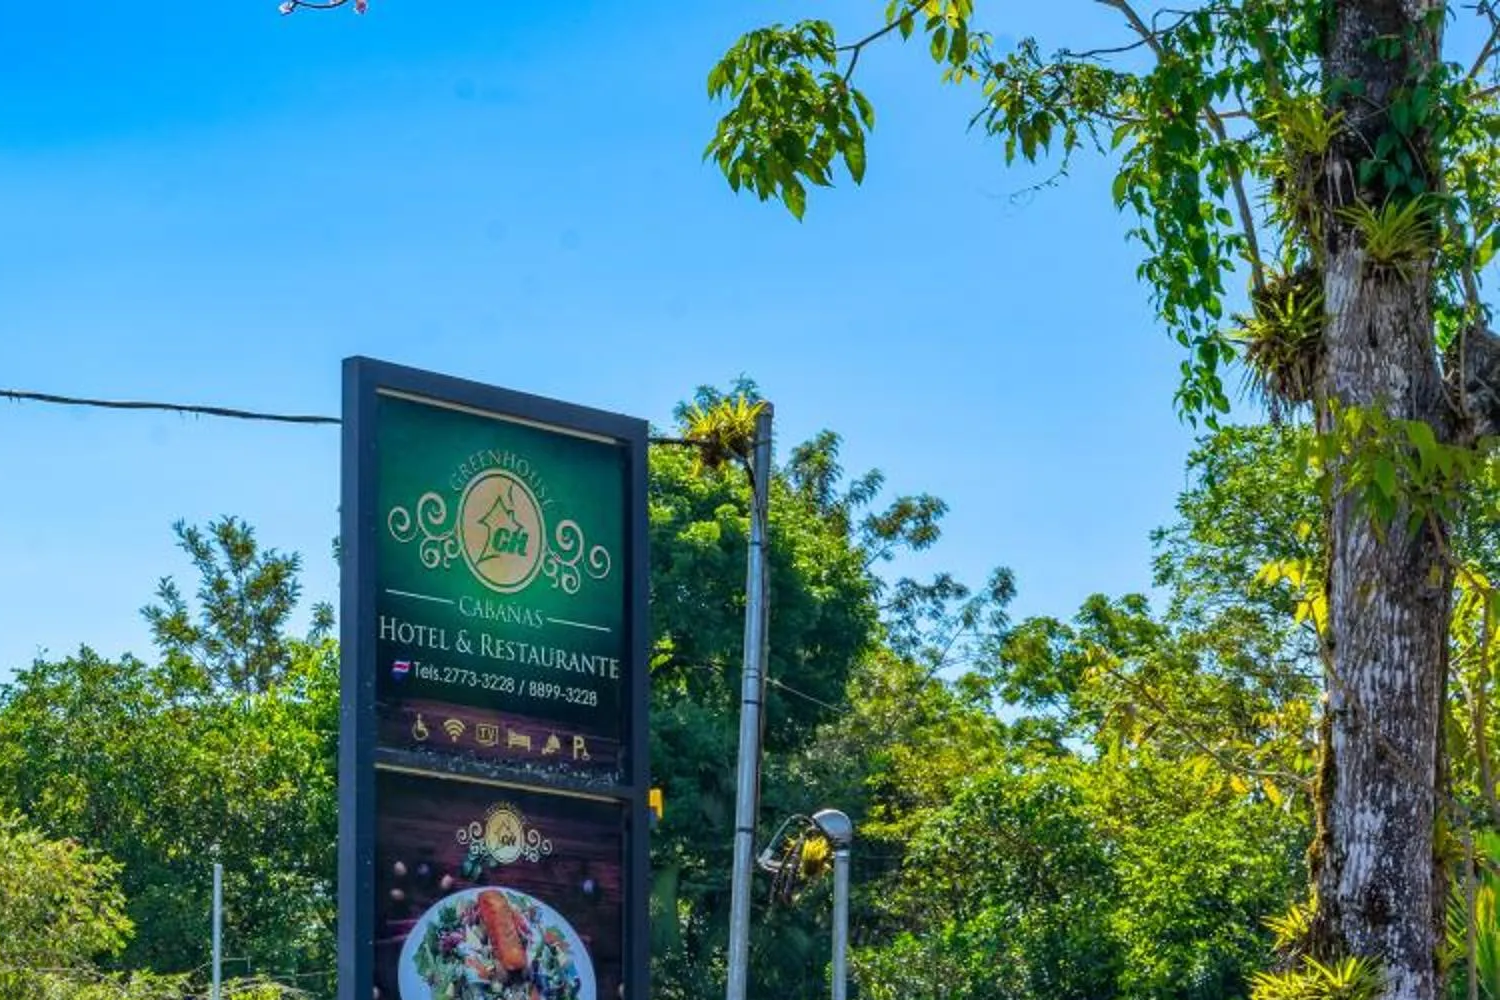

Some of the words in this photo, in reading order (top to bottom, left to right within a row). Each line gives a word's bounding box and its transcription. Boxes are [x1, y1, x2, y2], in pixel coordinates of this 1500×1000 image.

[458, 596, 544, 629] CABAÑAS
[379, 615, 450, 651] HOTEL
[455, 629, 474, 655] &
[480, 633, 620, 680] RESTAURANTE
[529, 681, 598, 707] 8899-3228
